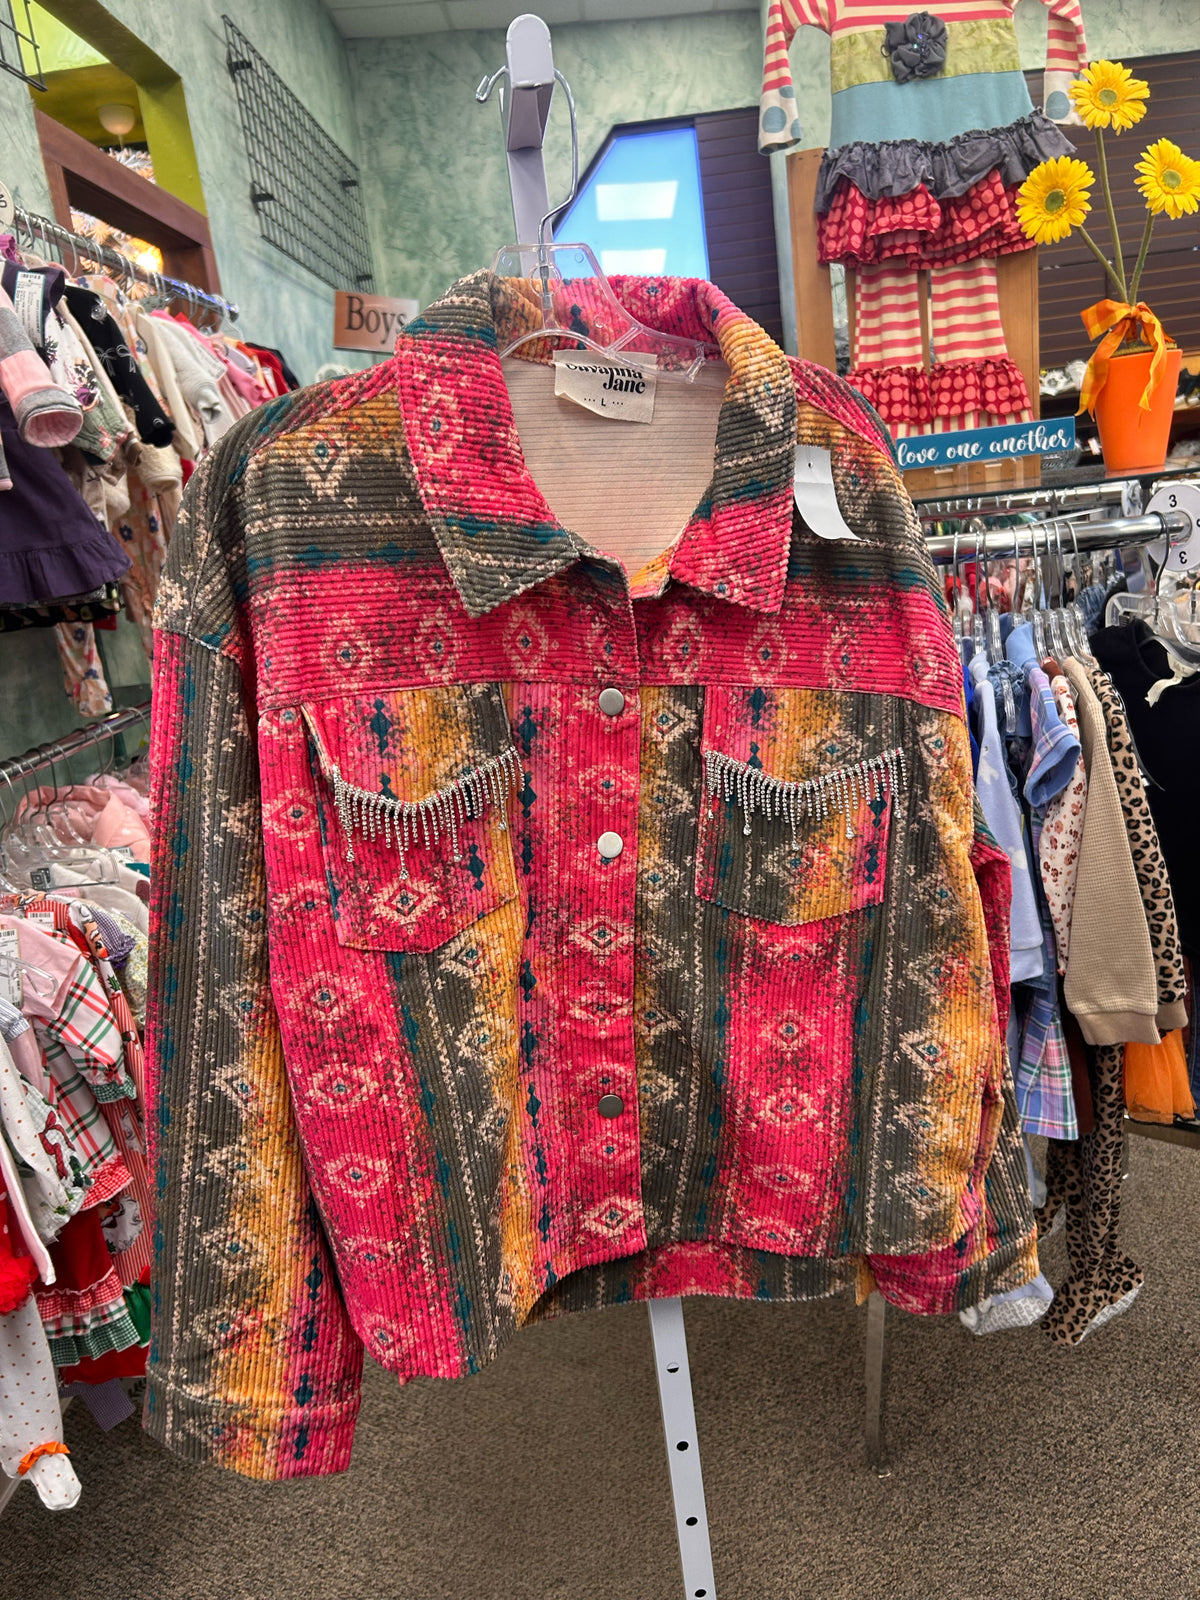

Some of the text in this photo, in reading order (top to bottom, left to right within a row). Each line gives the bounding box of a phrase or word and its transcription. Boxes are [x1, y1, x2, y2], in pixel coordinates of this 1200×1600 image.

[344, 295, 407, 345] Boys
[602, 369, 646, 394] Jane
[601, 397, 607, 407] L
[897, 425, 1071, 466] love one another
[1168, 494, 1178, 508] 3
